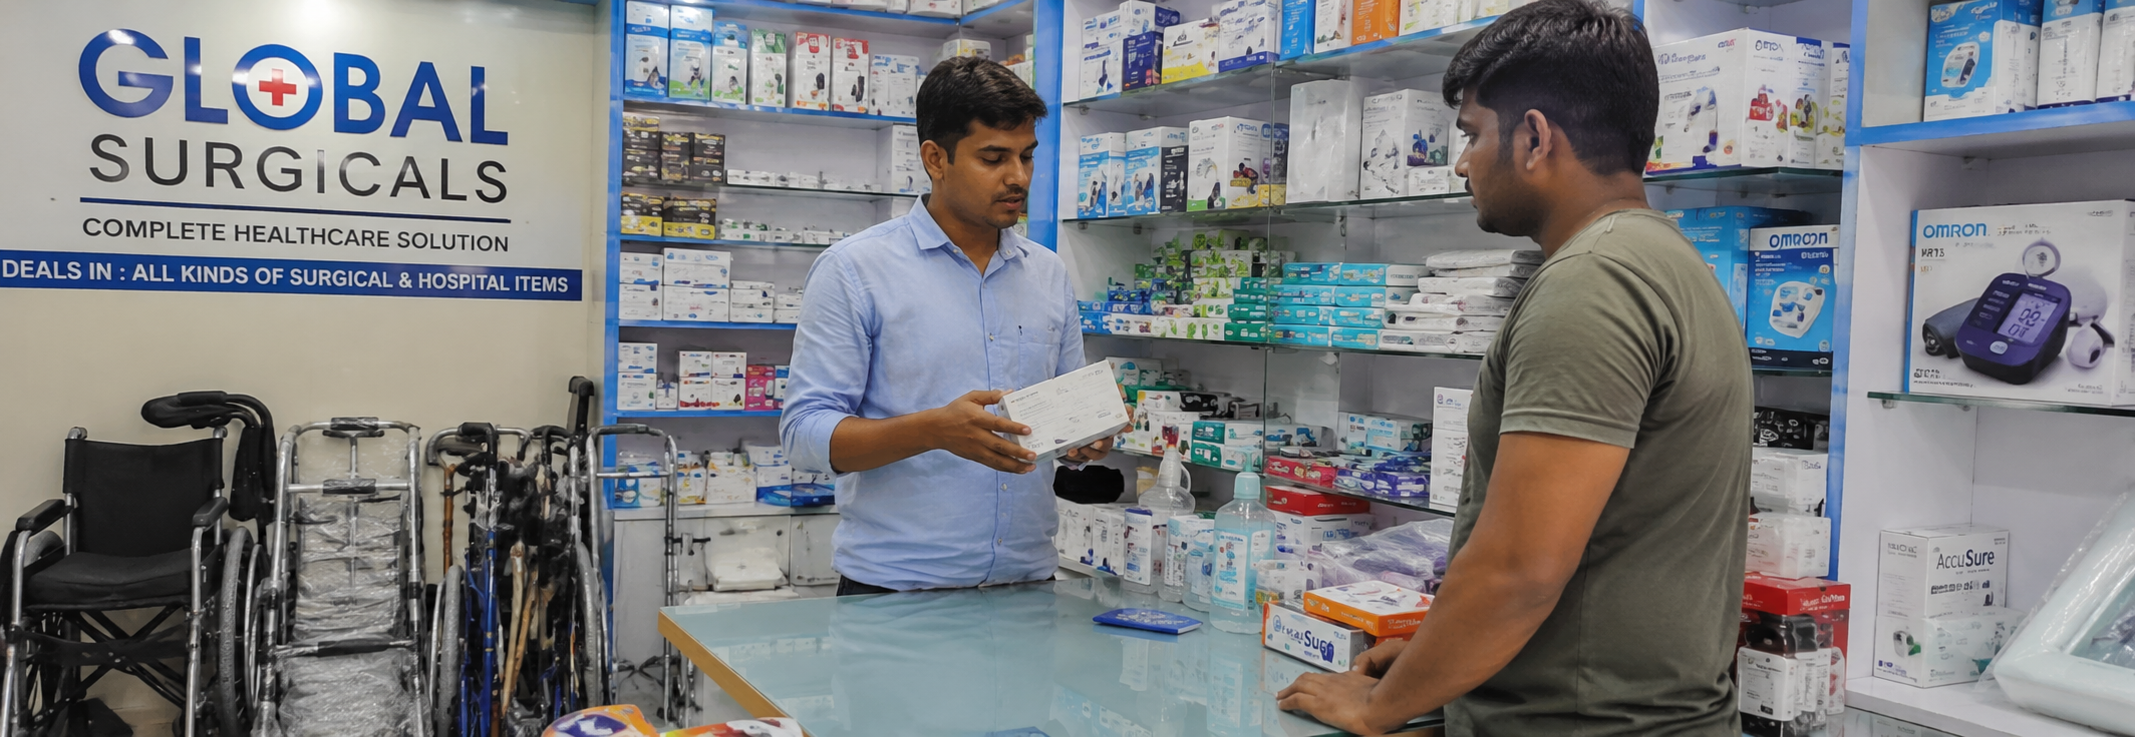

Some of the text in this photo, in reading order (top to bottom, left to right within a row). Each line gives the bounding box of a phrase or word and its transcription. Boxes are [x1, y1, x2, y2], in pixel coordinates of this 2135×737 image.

[78, 28, 508, 146] GLOBAL
[89, 134, 508, 202] SURGICALS
[82, 217, 509, 252] COMPLETE HEALTHCARE SOLUTION
[1923, 223, 1987, 239] OMRON
[2, 259, 82, 280] DEALS
[89, 261, 112, 281] IN
[132, 264, 174, 283] ALL
[181, 265, 248, 285] KINDS
[255, 266, 284, 285] OF
[289, 268, 394, 288] SURGICAL
[398, 271, 413, 289] &
[418, 272, 511, 291] HOSPITAL
[514, 275, 569, 293] ITEMS
[1936, 549, 1995, 570] AccuSure
